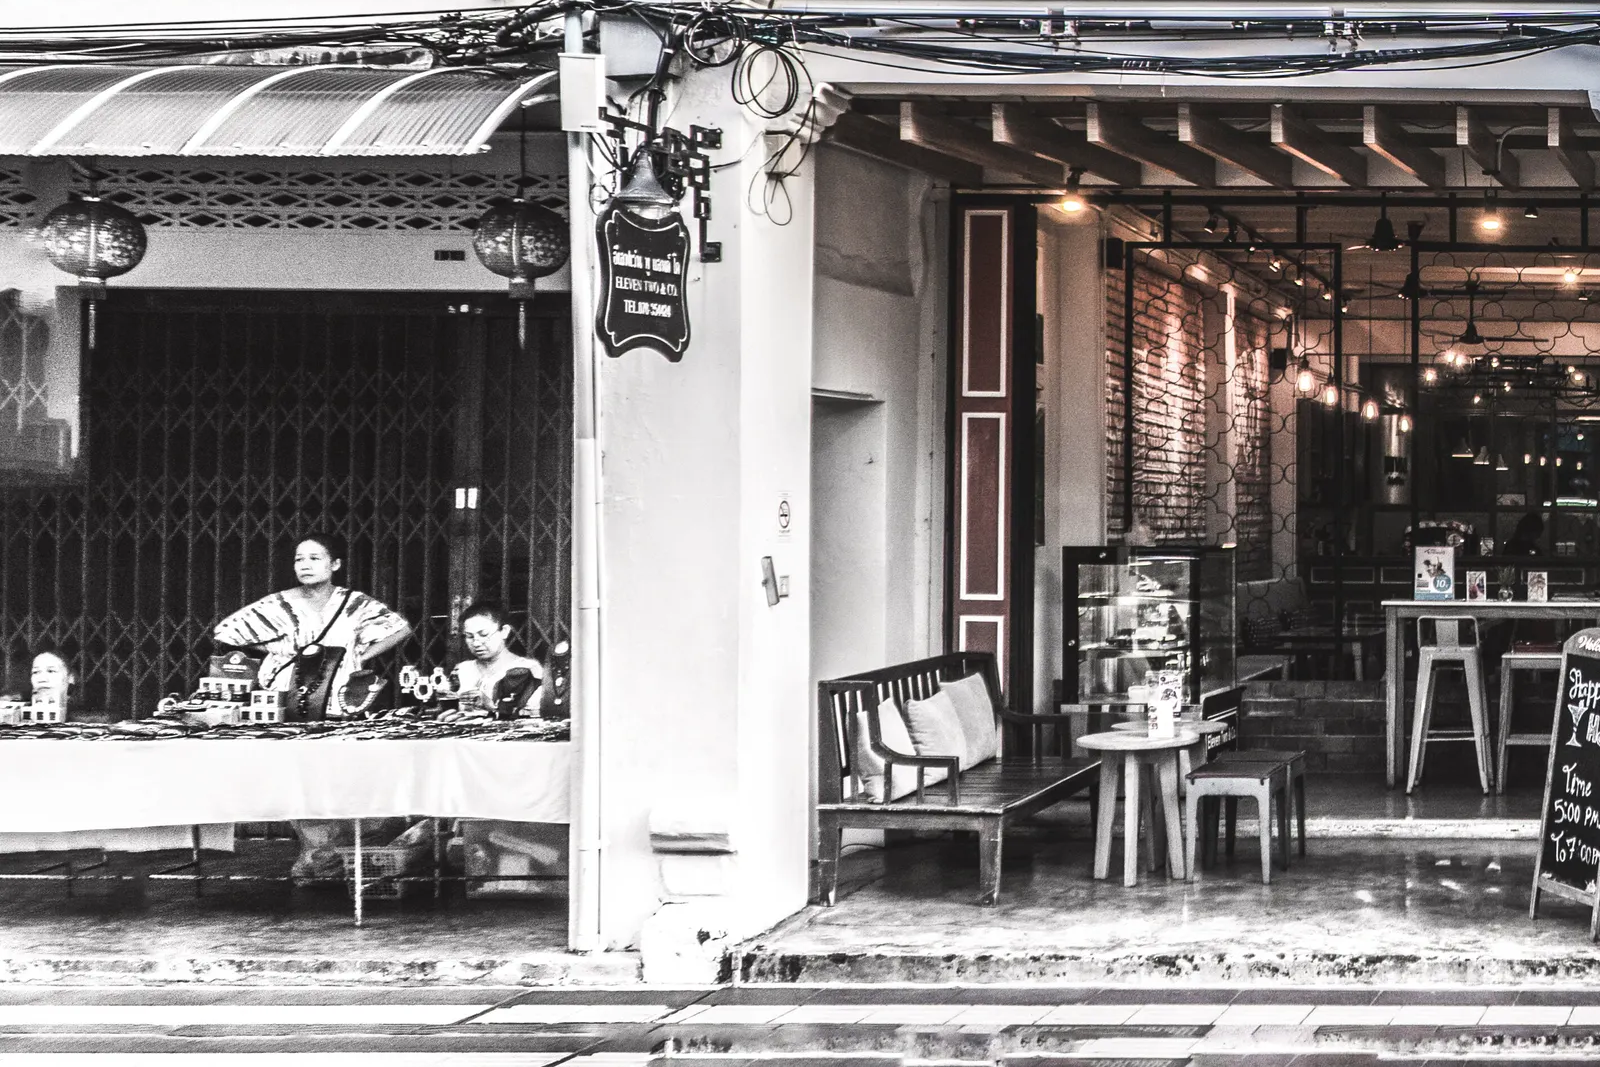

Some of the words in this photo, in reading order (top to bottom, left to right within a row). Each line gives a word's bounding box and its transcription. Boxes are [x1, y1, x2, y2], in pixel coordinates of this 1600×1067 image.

[615, 275, 643, 292] ELEVEN
[1562, 762, 1592, 797] Time
[1554, 799, 1580, 824] 5:00
[1550, 830, 1567, 862] To
